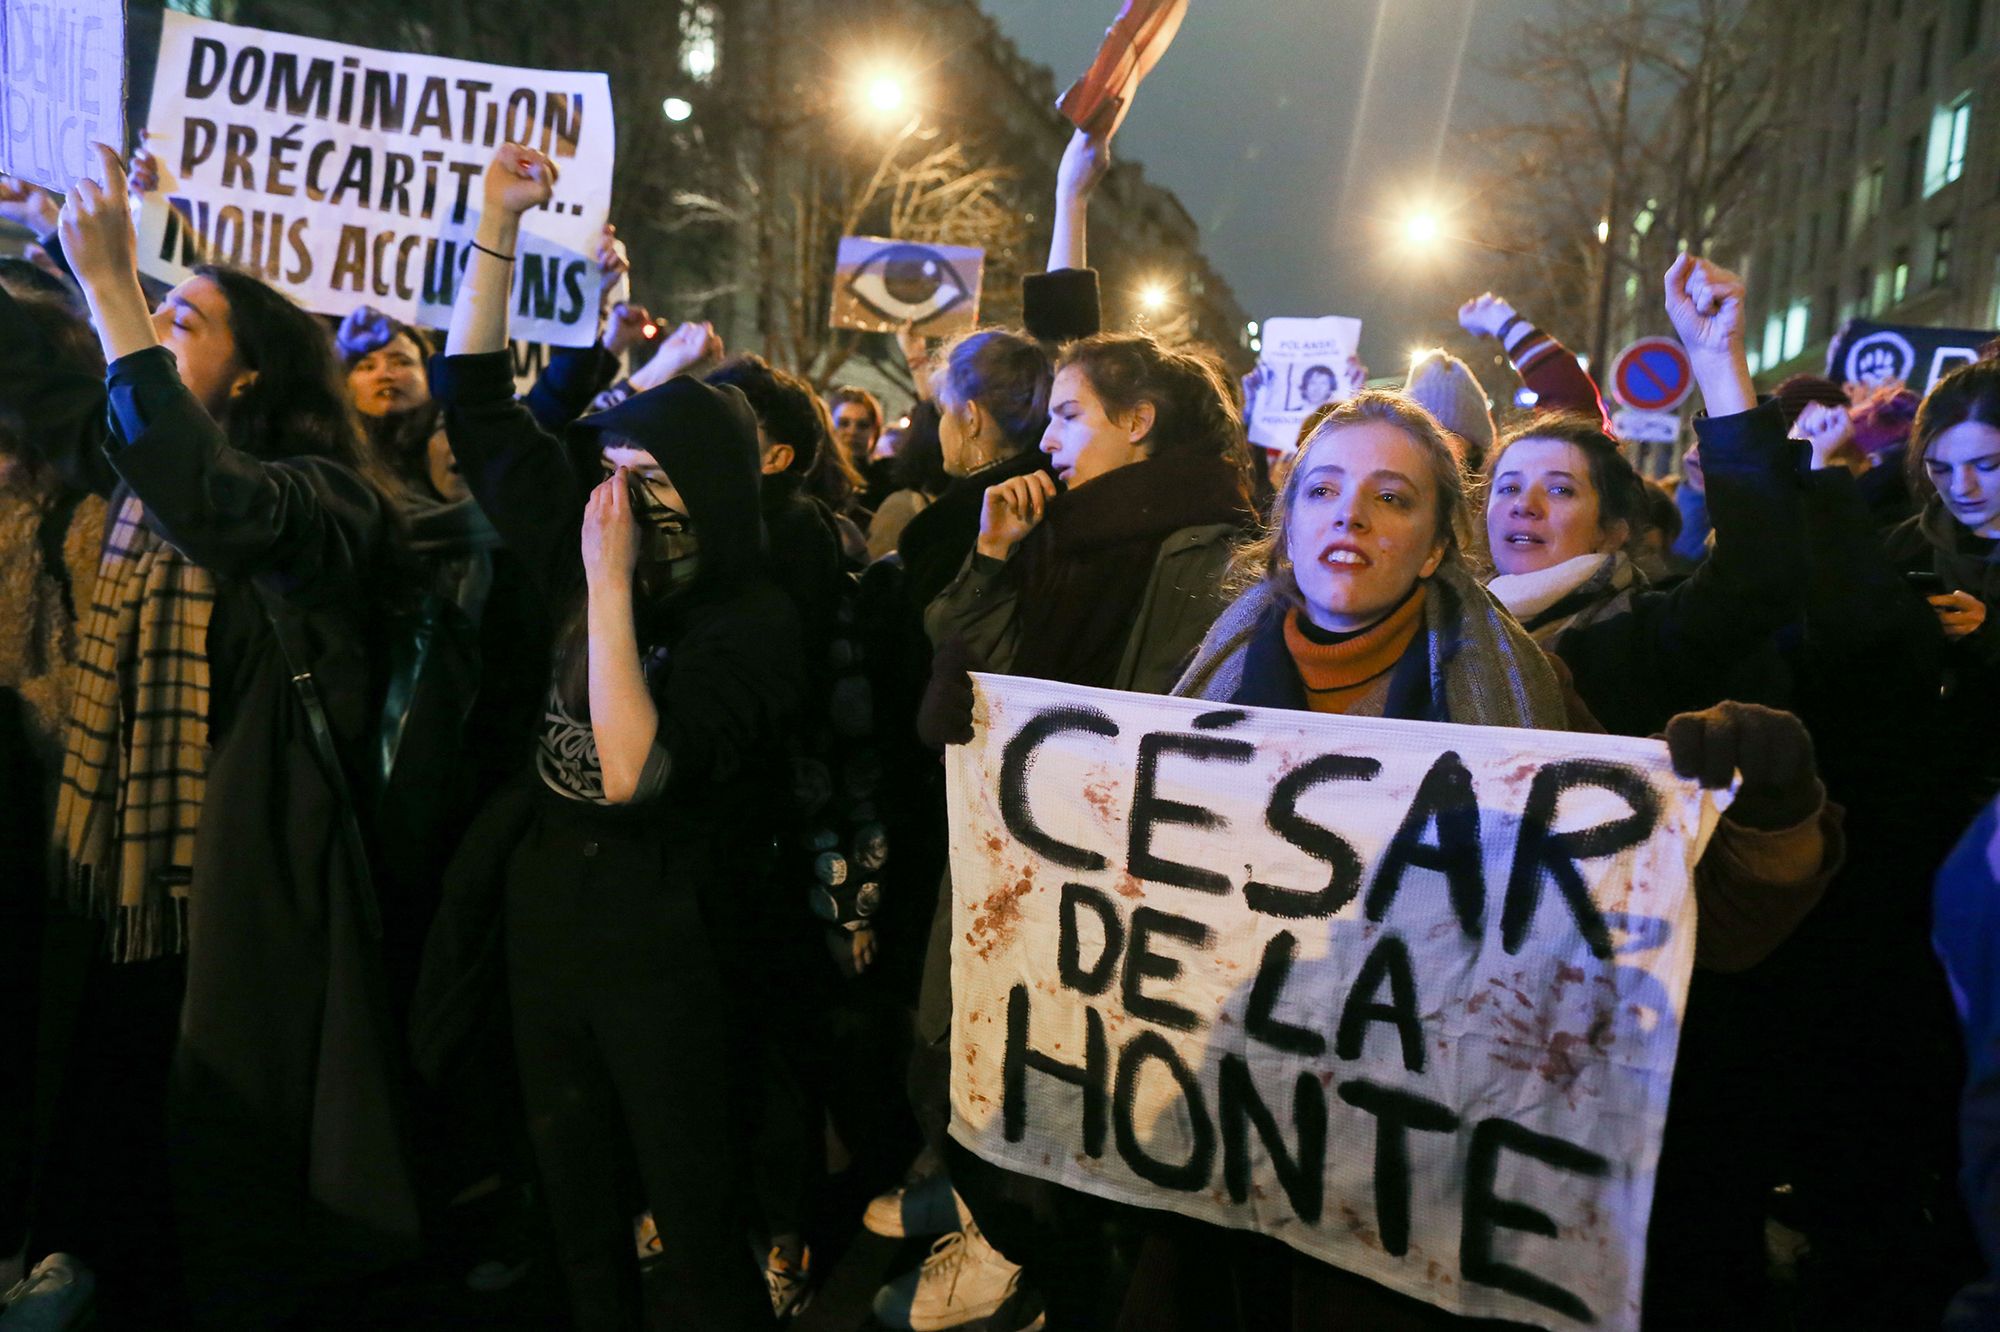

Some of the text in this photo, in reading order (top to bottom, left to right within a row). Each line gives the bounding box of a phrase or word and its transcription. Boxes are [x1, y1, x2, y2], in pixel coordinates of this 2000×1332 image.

[160, 196, 587, 325] NOUS ACCUNS
[999, 704, 1663, 960] CÉSAR
[1057, 882, 1428, 1075] DE LA
[1003, 984, 1611, 1326] HONTE
